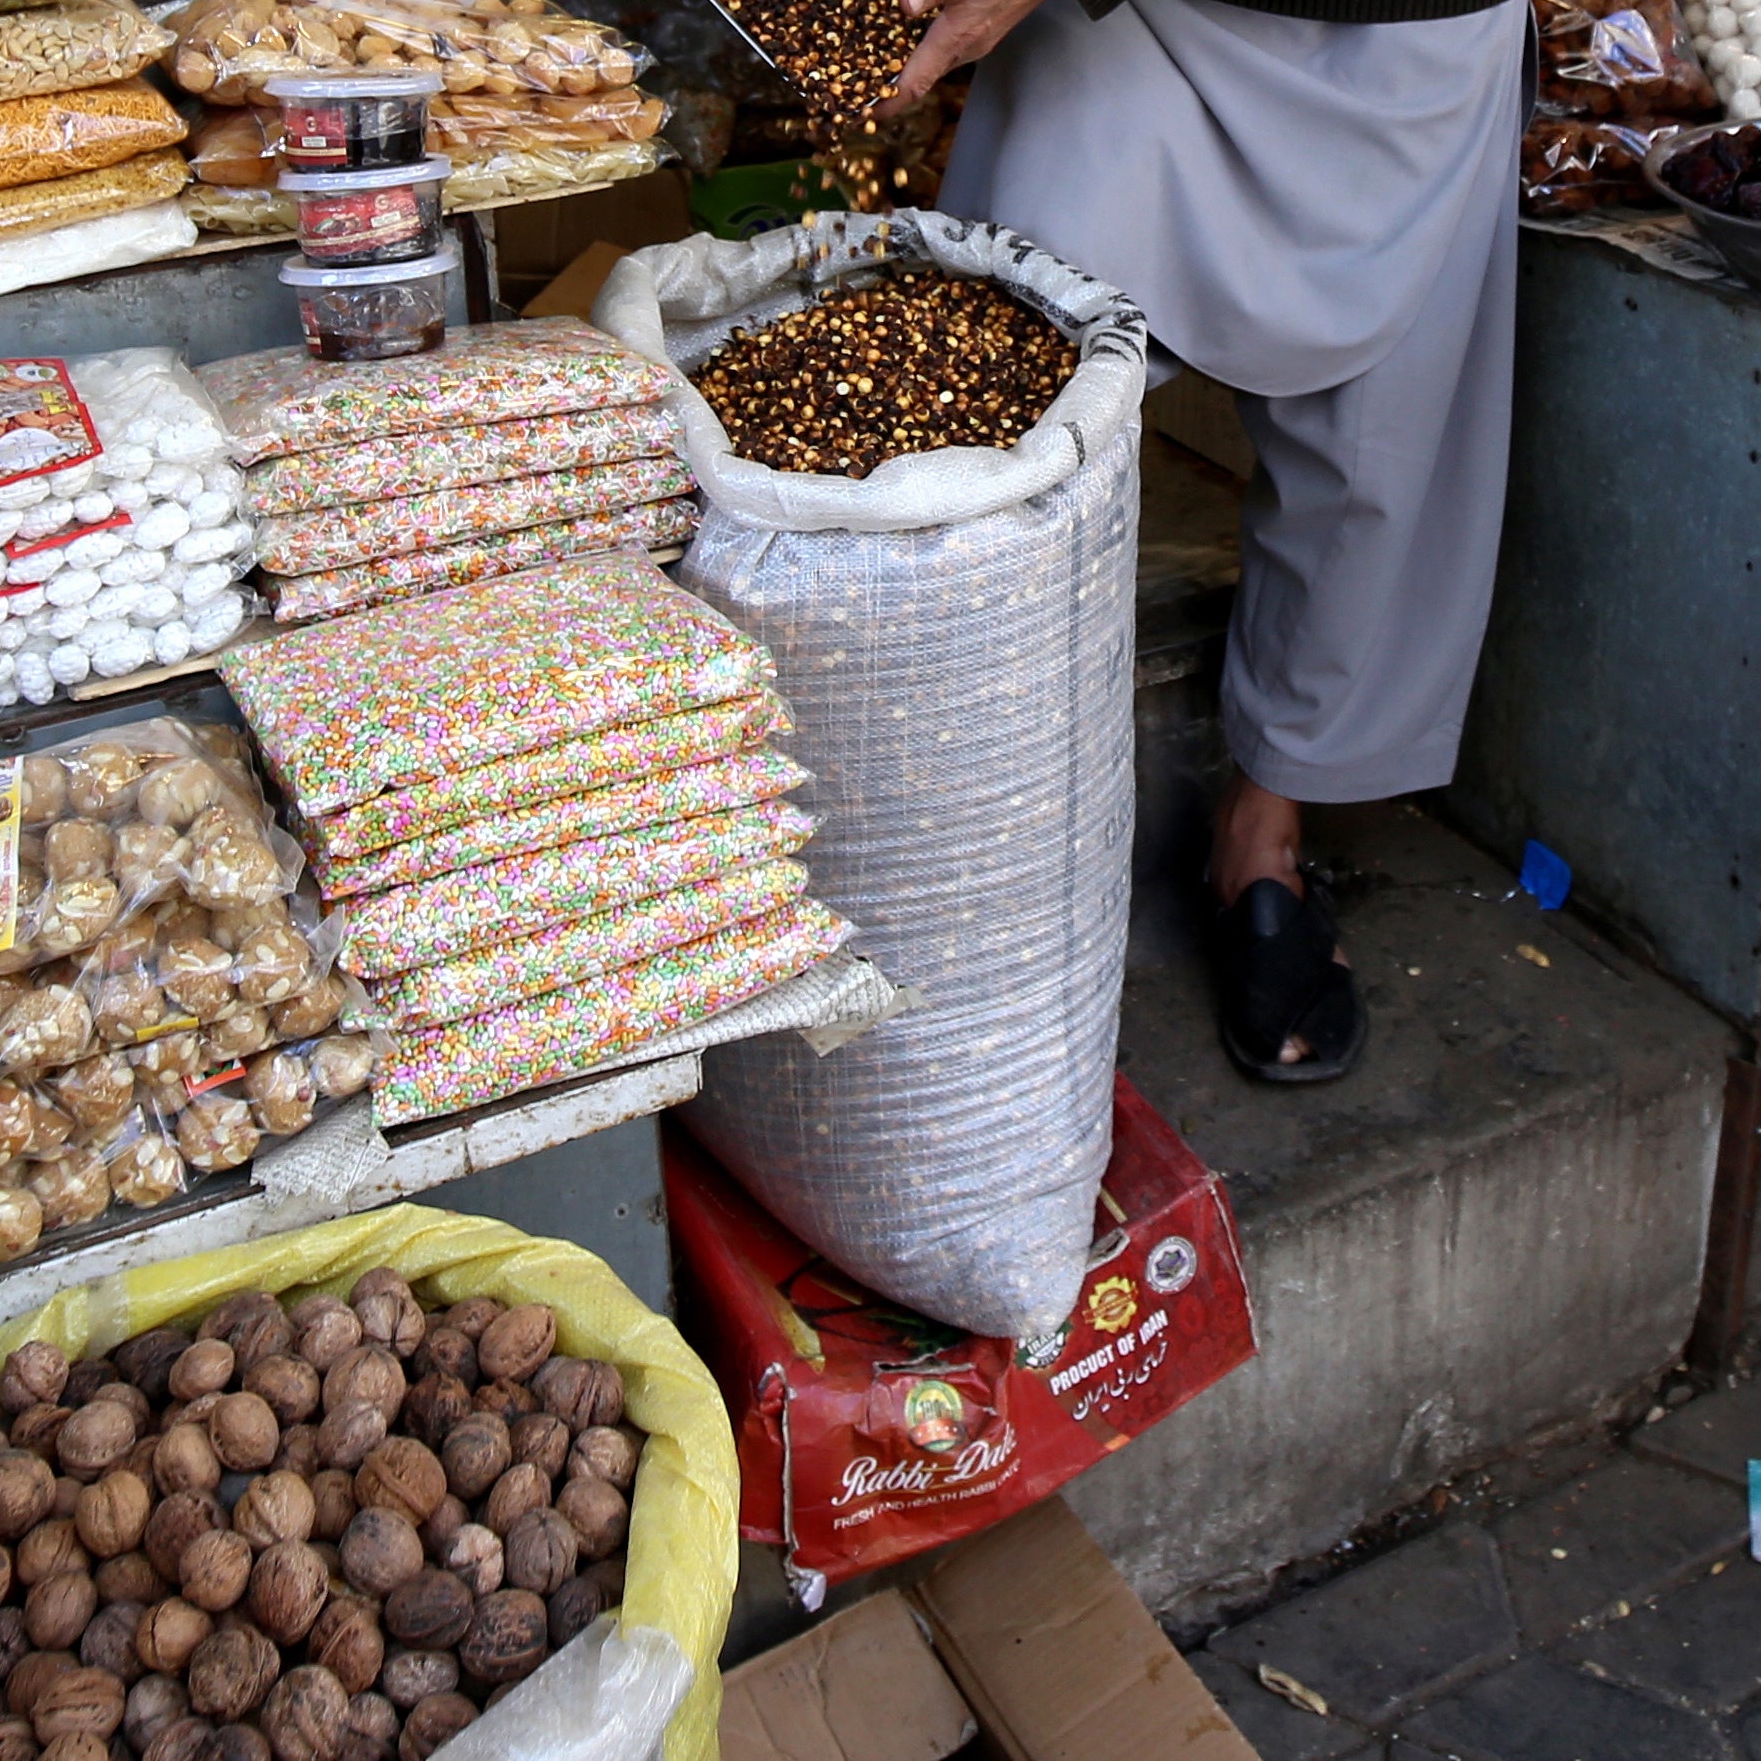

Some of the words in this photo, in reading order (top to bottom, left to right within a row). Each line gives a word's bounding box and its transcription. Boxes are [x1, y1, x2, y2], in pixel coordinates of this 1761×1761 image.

[1116, 1332, 1137, 1356] OF
[1138, 1309, 1170, 1346] IRAN
[831, 1456, 935, 1507] Rabbi
[833, 1507, 876, 1531] FRESH
[877, 1499, 905, 1514] AND
[907, 1492, 958, 1509] HEALTH
